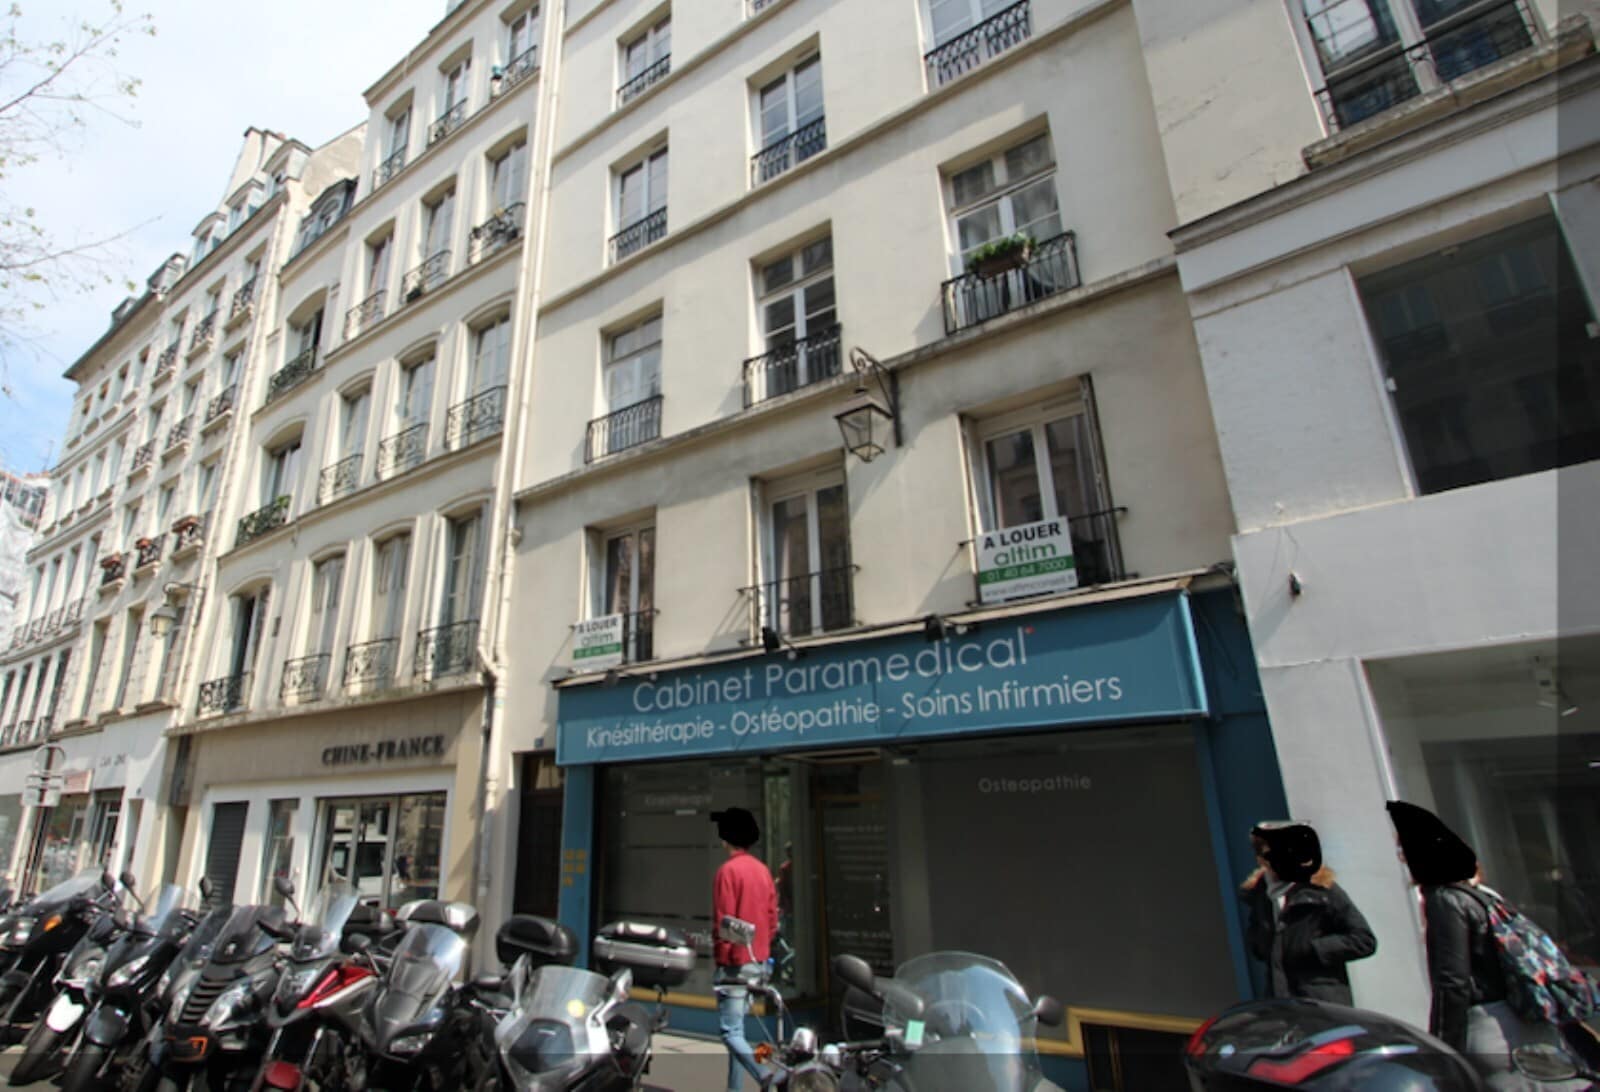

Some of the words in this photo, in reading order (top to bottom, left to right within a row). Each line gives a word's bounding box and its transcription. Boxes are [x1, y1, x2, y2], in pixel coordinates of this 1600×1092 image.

[983, 536, 995, 550] A
[999, 522, 1062, 546] LOUER
[633, 667, 753, 713] Cabinet
[764, 626, 1027, 697] Paramedical
[585, 715, 715, 749] Kinésithérapie
[730, 698, 880, 736] Ostéopathie
[902, 689, 973, 719] Soins
[977, 674, 1122, 713] Infirmiers
[321, 735, 446, 766] CHINE-FRANCE
